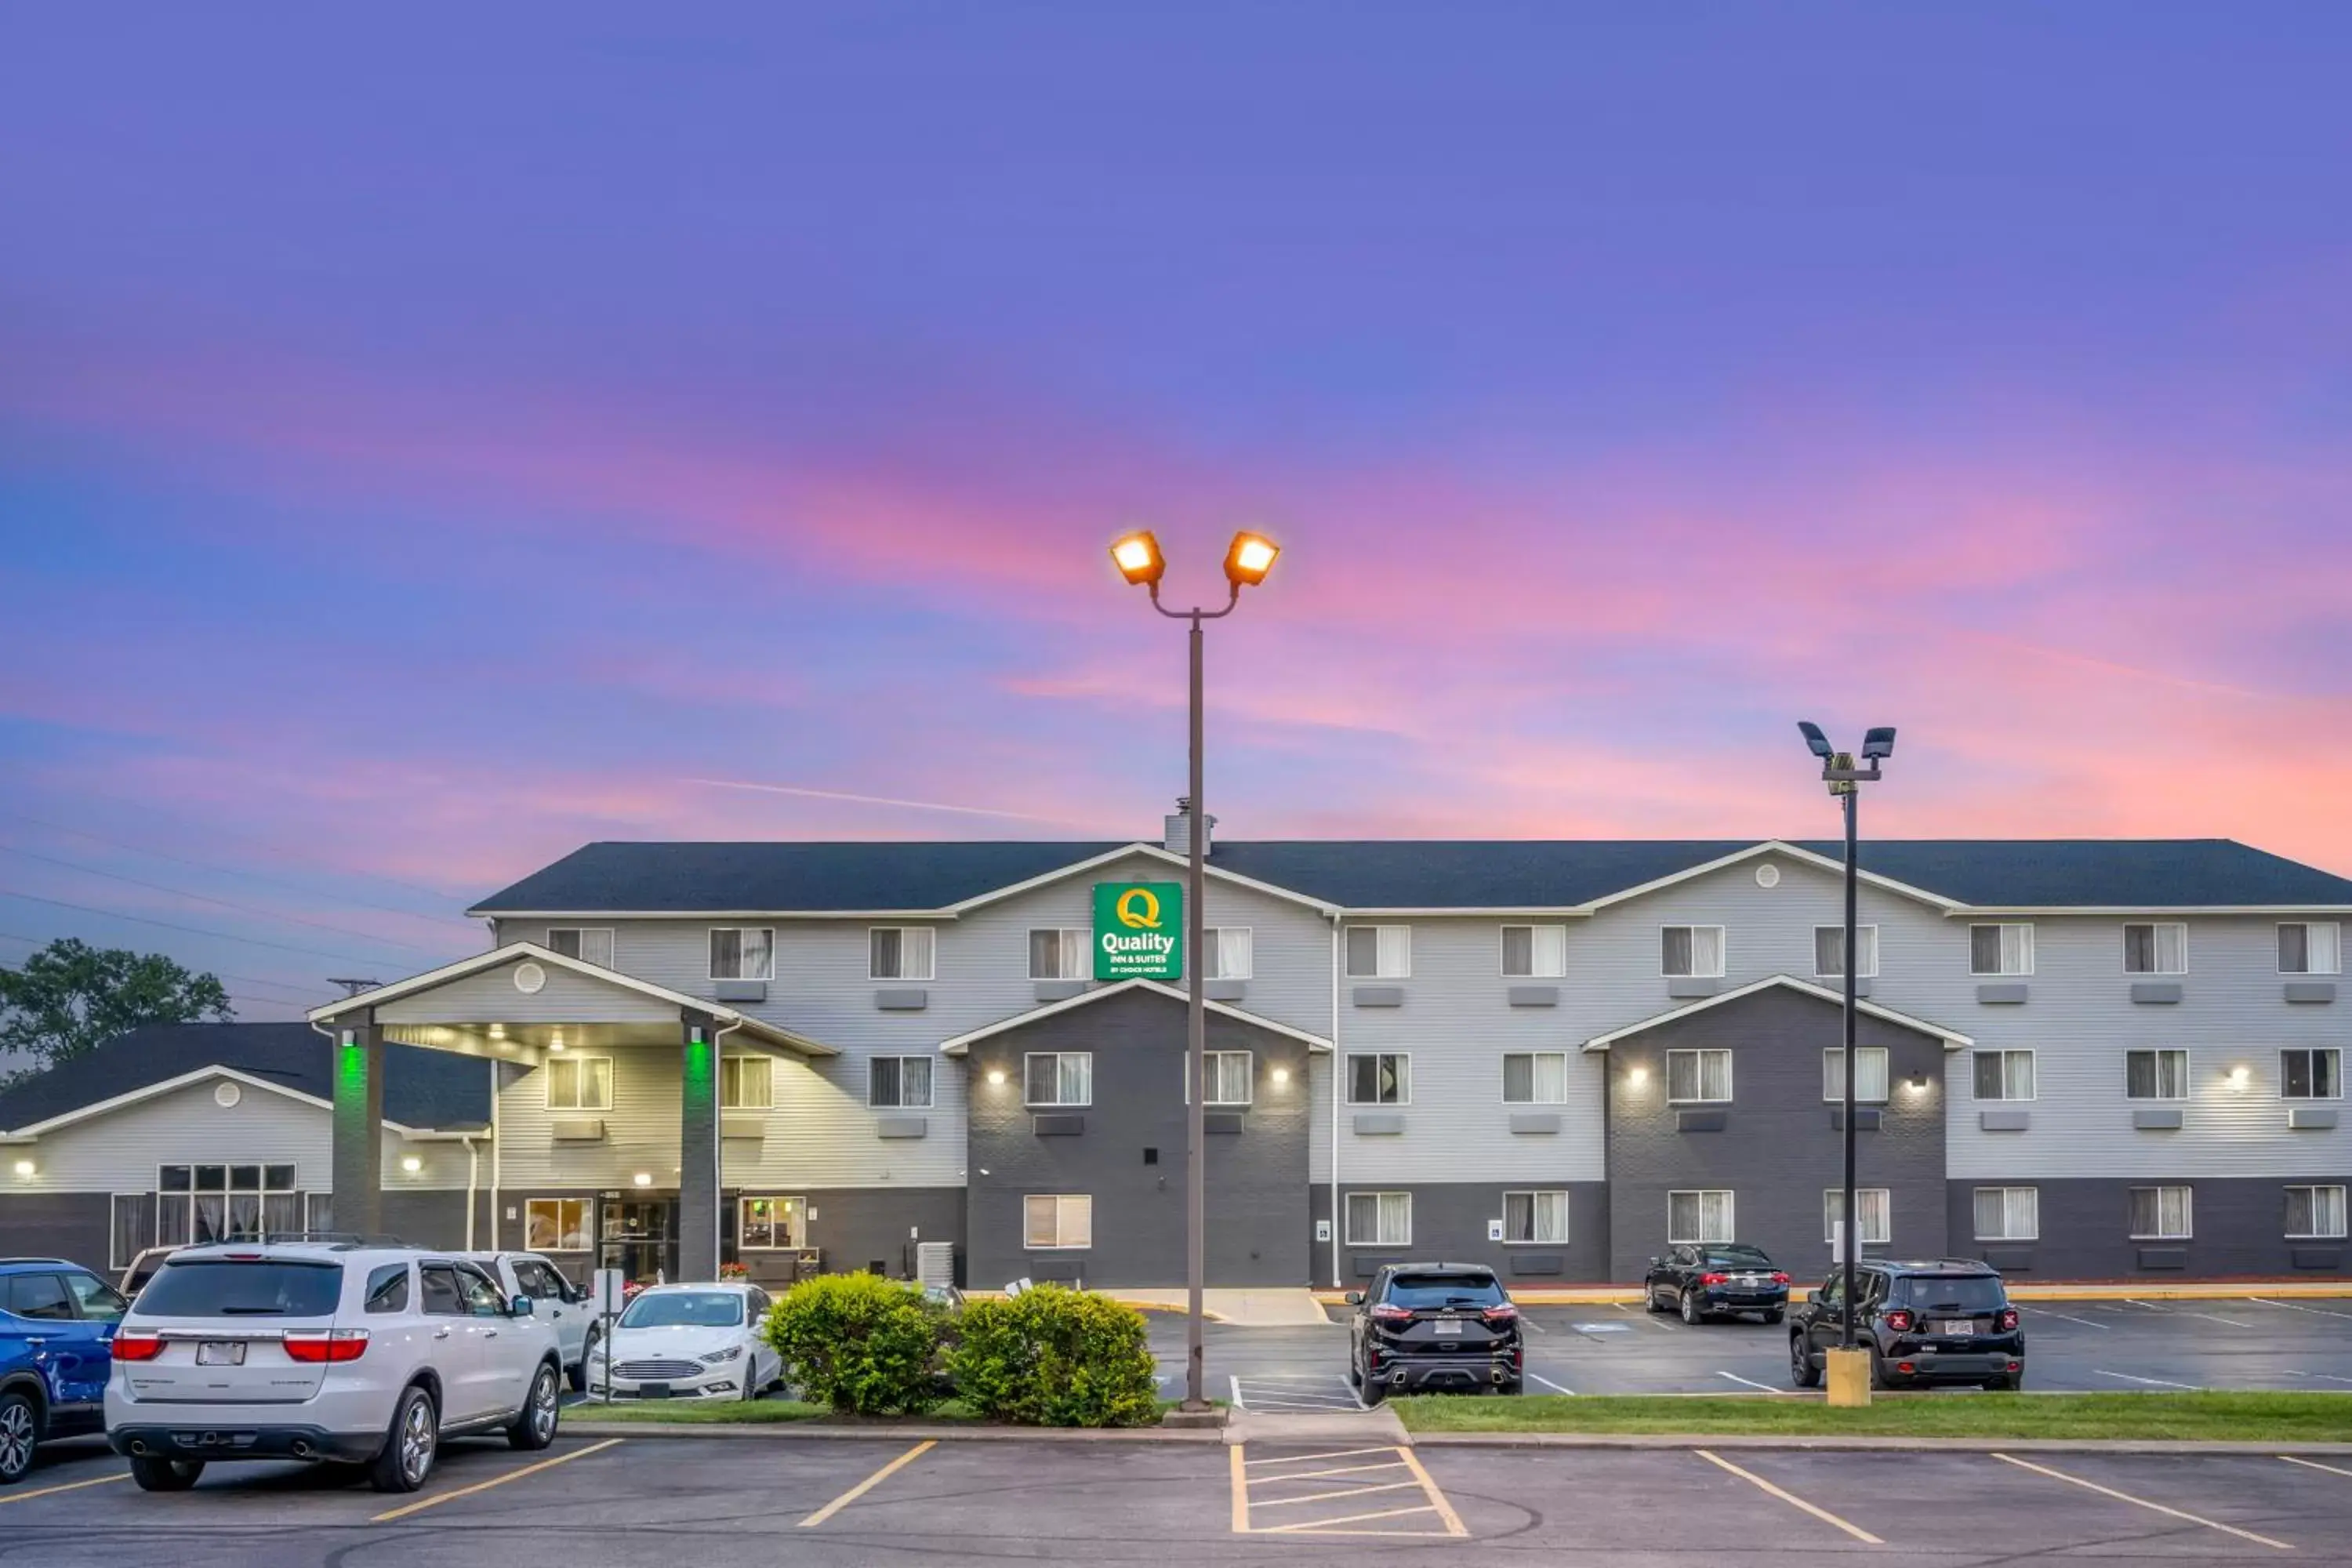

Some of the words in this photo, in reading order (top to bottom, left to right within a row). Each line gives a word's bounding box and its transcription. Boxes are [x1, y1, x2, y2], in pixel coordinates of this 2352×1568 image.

[1116, 888, 1163, 928] Q
[1102, 933, 1174, 954] Quality
[1110, 955, 1127, 964] INN
[1128, 955, 1134, 964] &
[1135, 955, 1167, 964] SUITES
